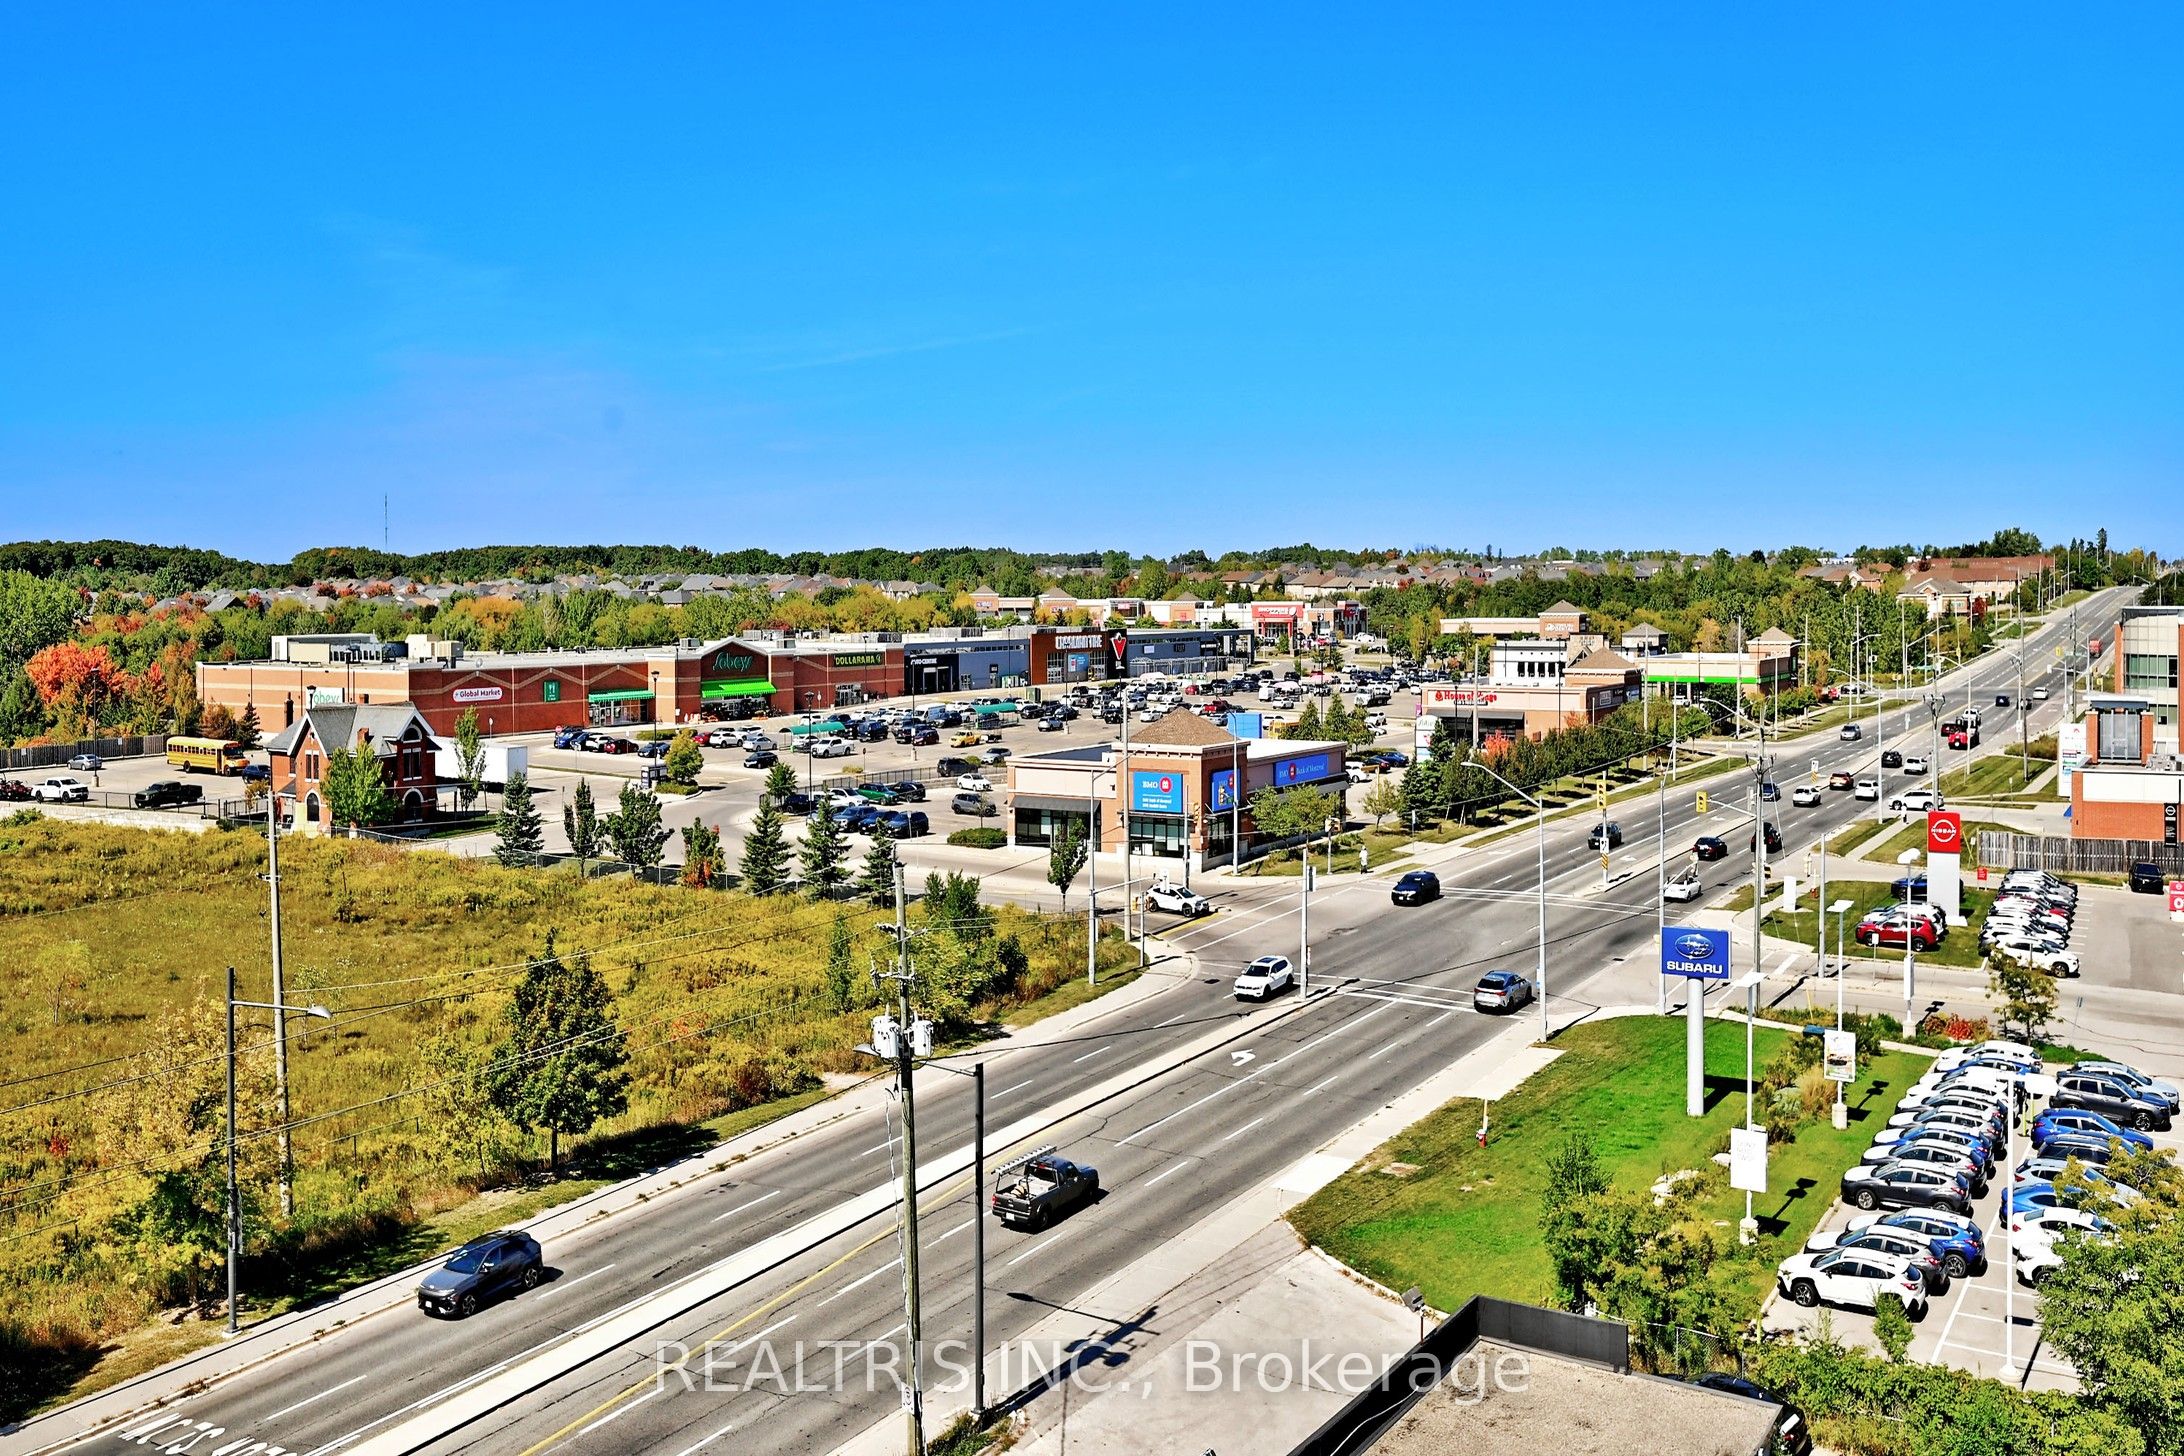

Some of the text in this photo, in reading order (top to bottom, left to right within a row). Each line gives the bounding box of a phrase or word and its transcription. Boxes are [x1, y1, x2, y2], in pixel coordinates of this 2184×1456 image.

[712, 652, 753, 672] Sobeys
[835, 655, 875, 666] DOLLARAMA
[459, 688, 501, 699] Global Market
[1444, 690, 1466, 700] House
[1666, 960, 1723, 974] SUBARU
